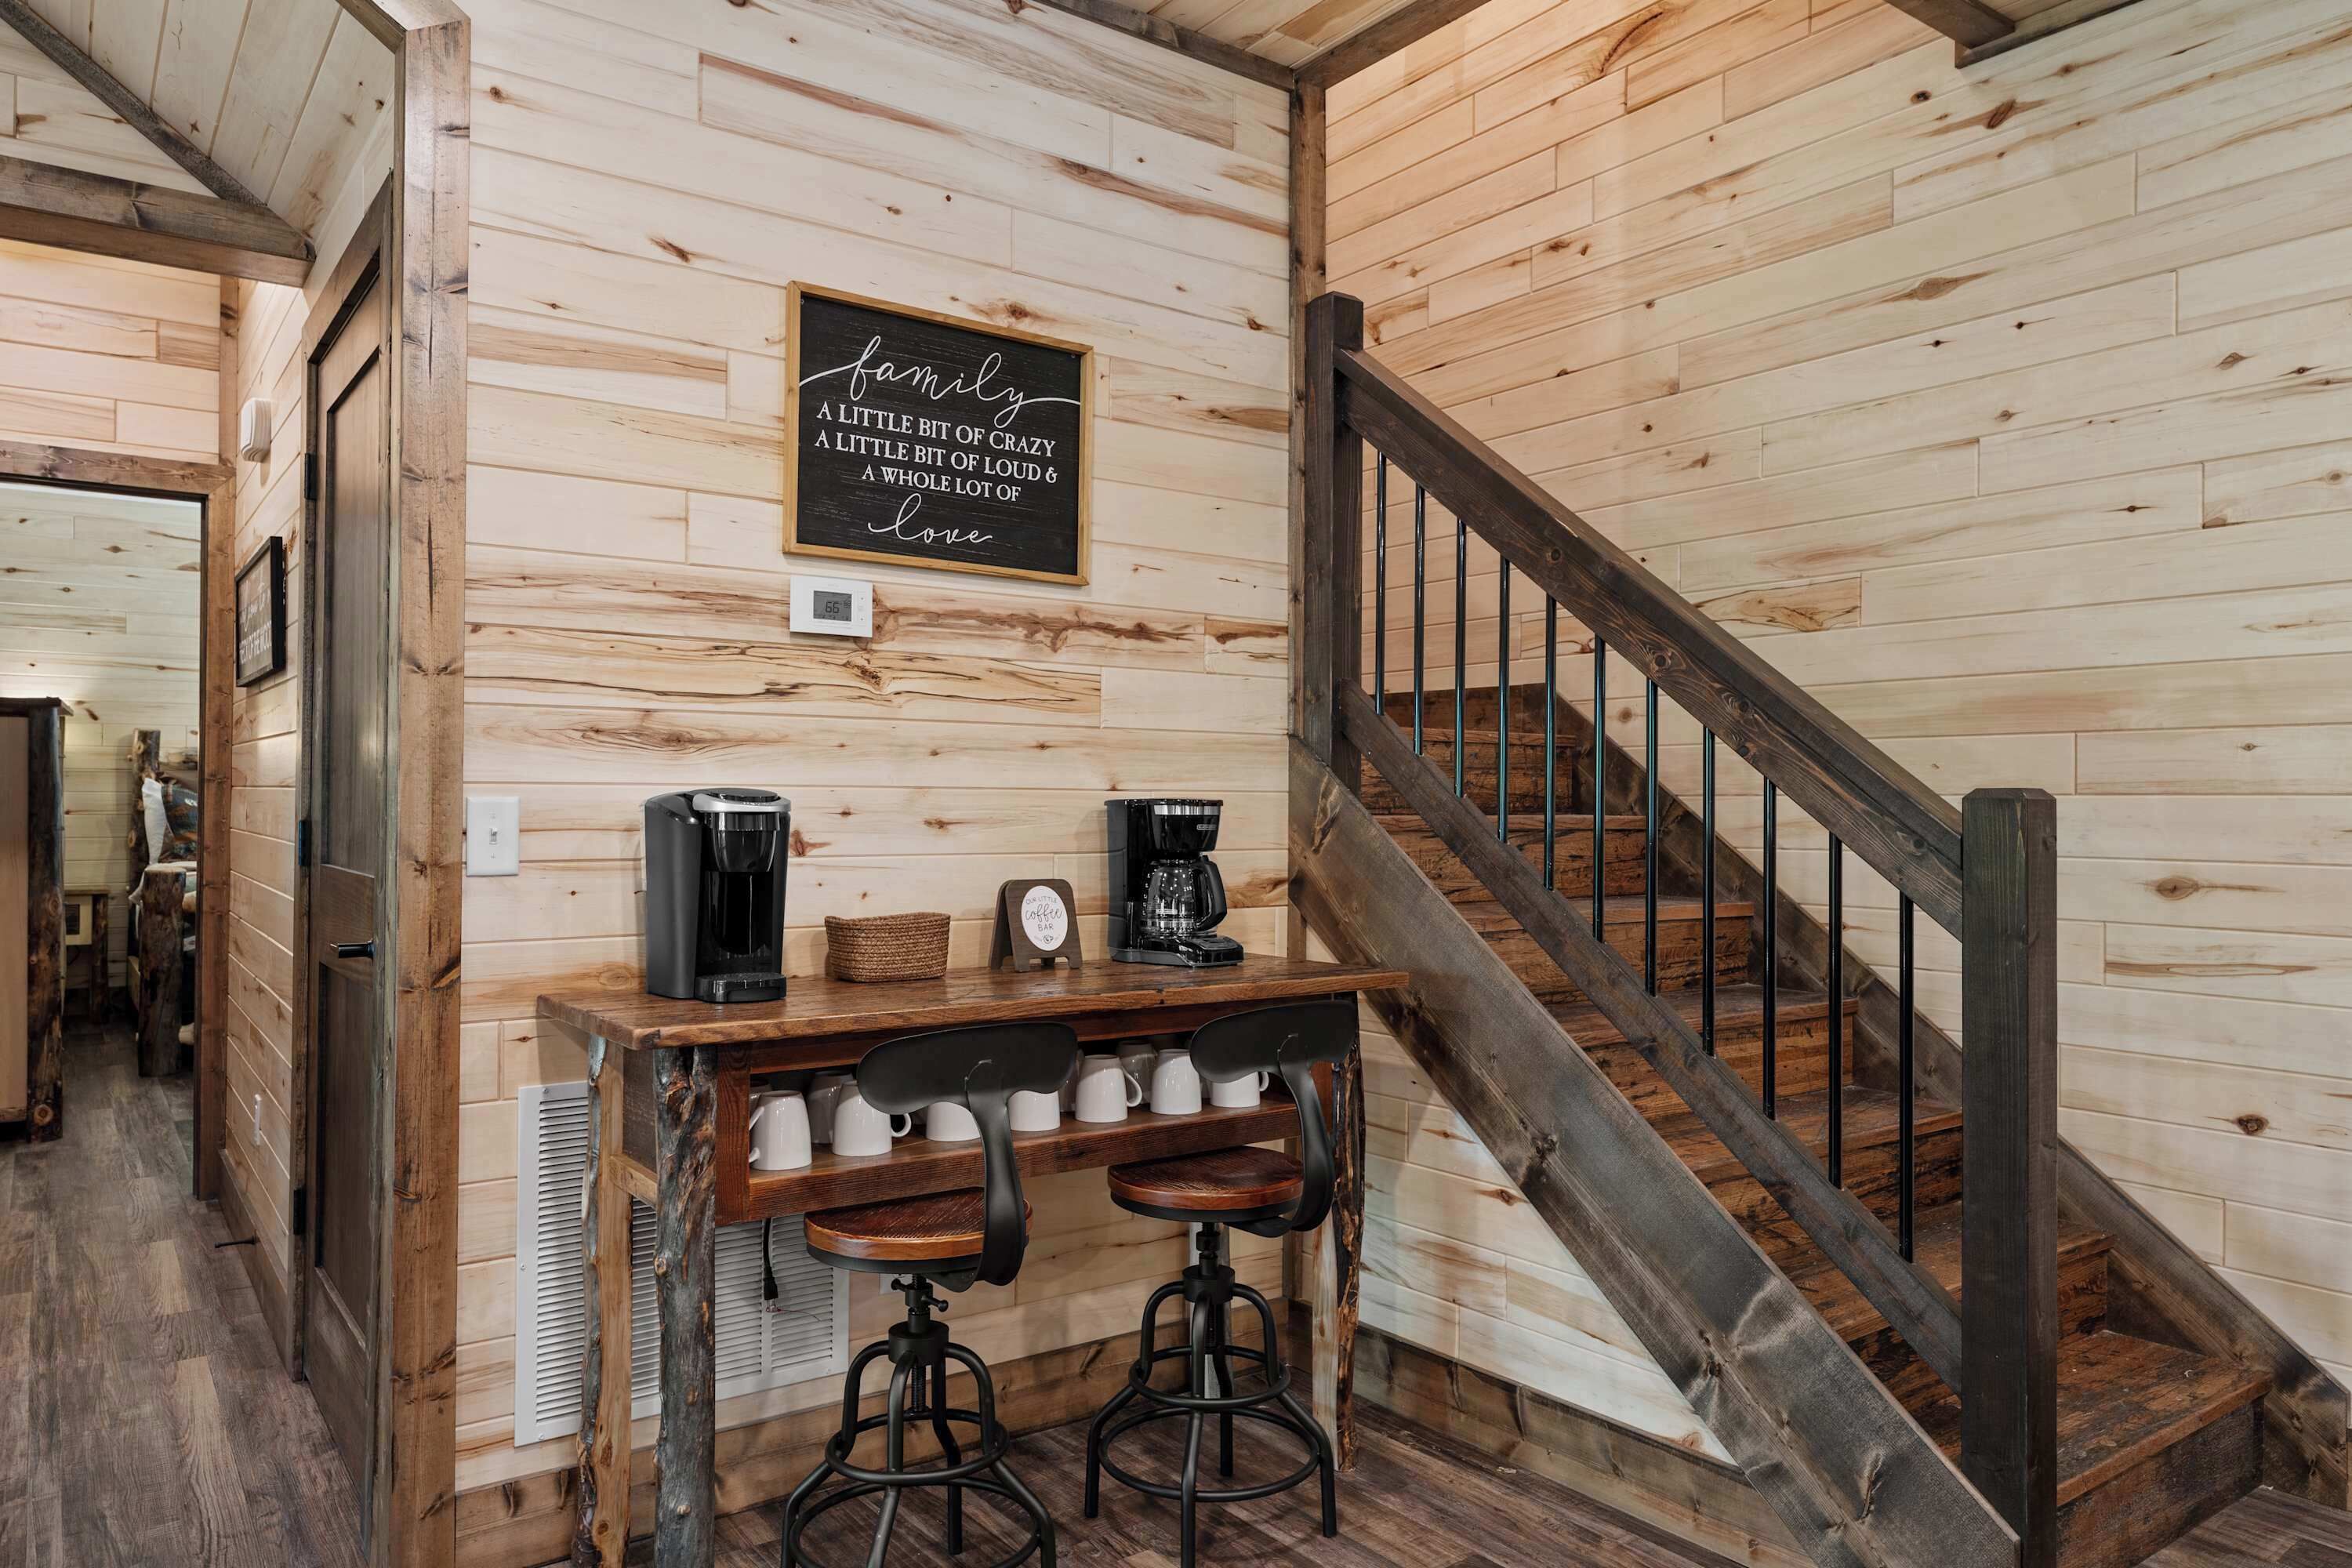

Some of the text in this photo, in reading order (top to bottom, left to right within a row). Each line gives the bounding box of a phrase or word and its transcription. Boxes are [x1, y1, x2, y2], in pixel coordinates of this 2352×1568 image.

[800, 335, 1080, 429] family
[814, 429, 1058, 484] A LITTLE BIT OF LOUD &
[816, 401, 1056, 459] A LITTLE BIT OF CRAZY
[861, 463, 1022, 502] A WHOLE LOT OF
[867, 492, 993, 544] love
[1025, 903, 1063, 922] coffee
